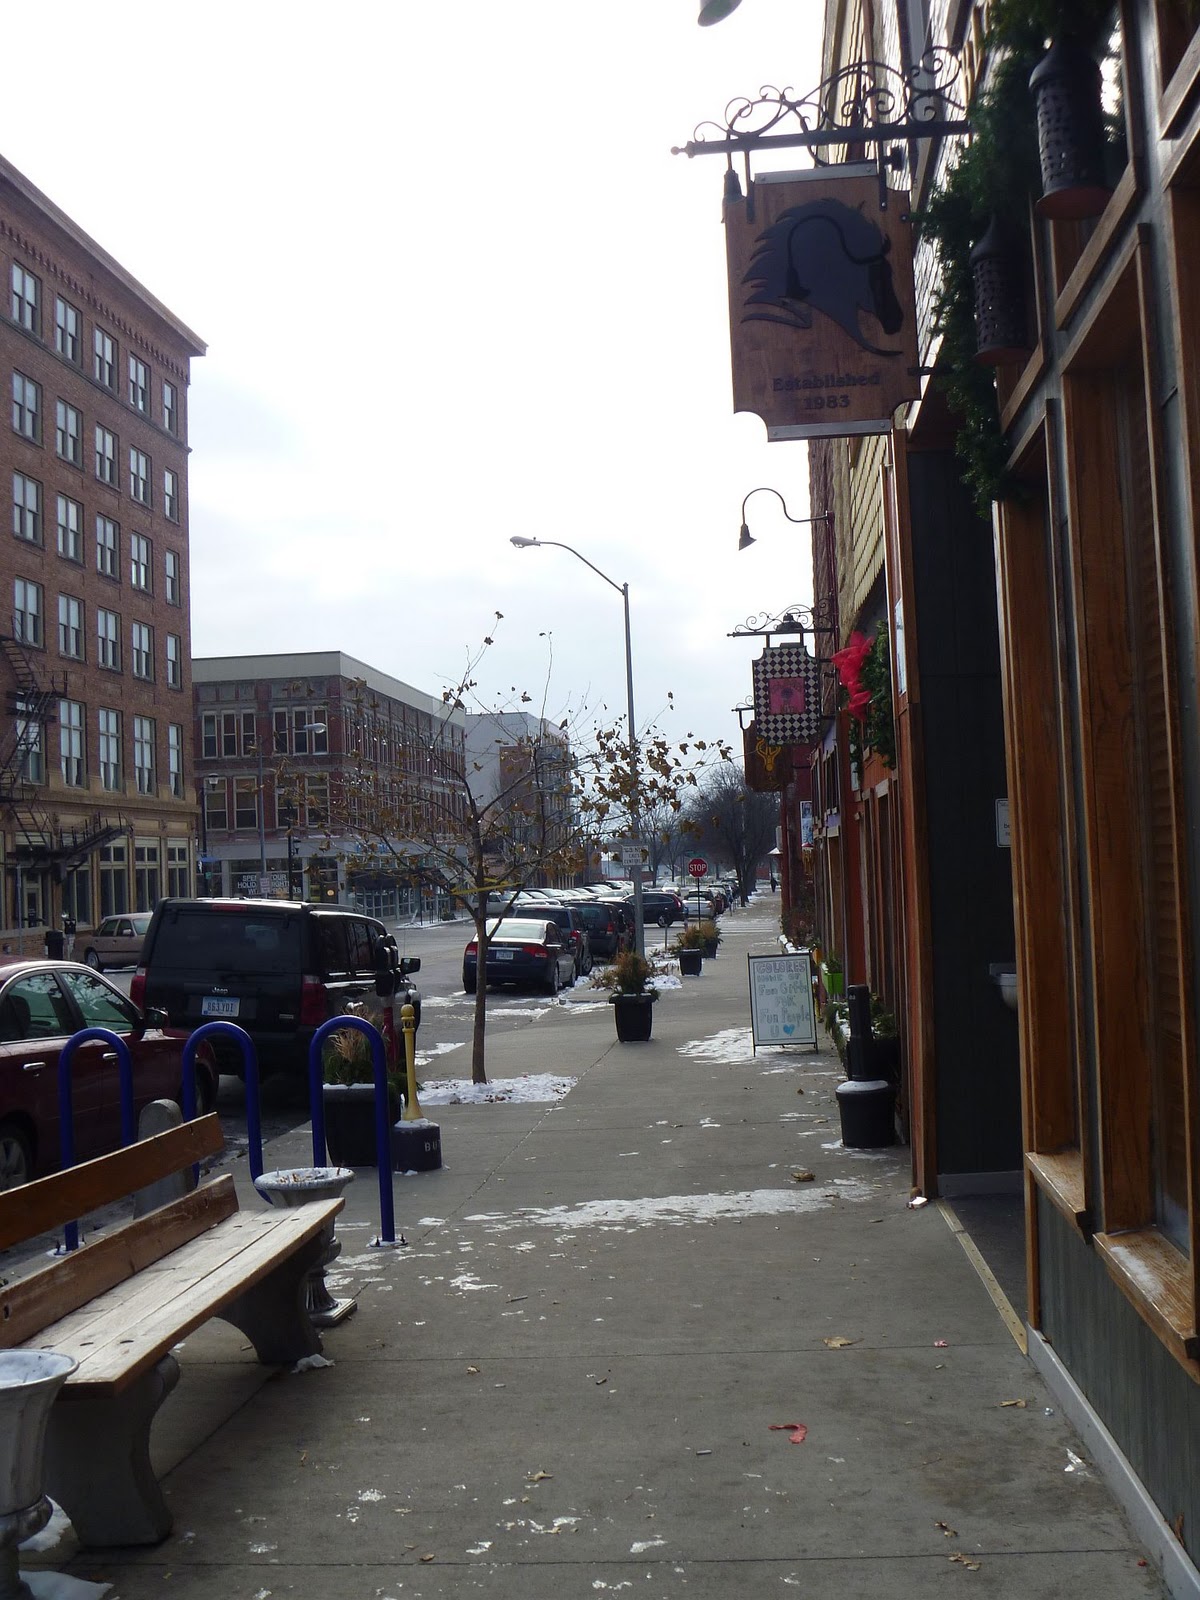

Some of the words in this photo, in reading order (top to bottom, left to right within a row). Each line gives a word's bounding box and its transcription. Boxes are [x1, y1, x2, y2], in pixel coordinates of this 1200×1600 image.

[773, 372, 881, 391] Established
[804, 394, 849, 410] 1983
[689, 863, 706, 872] STOP
[211, 986, 229, 994] Jeep
